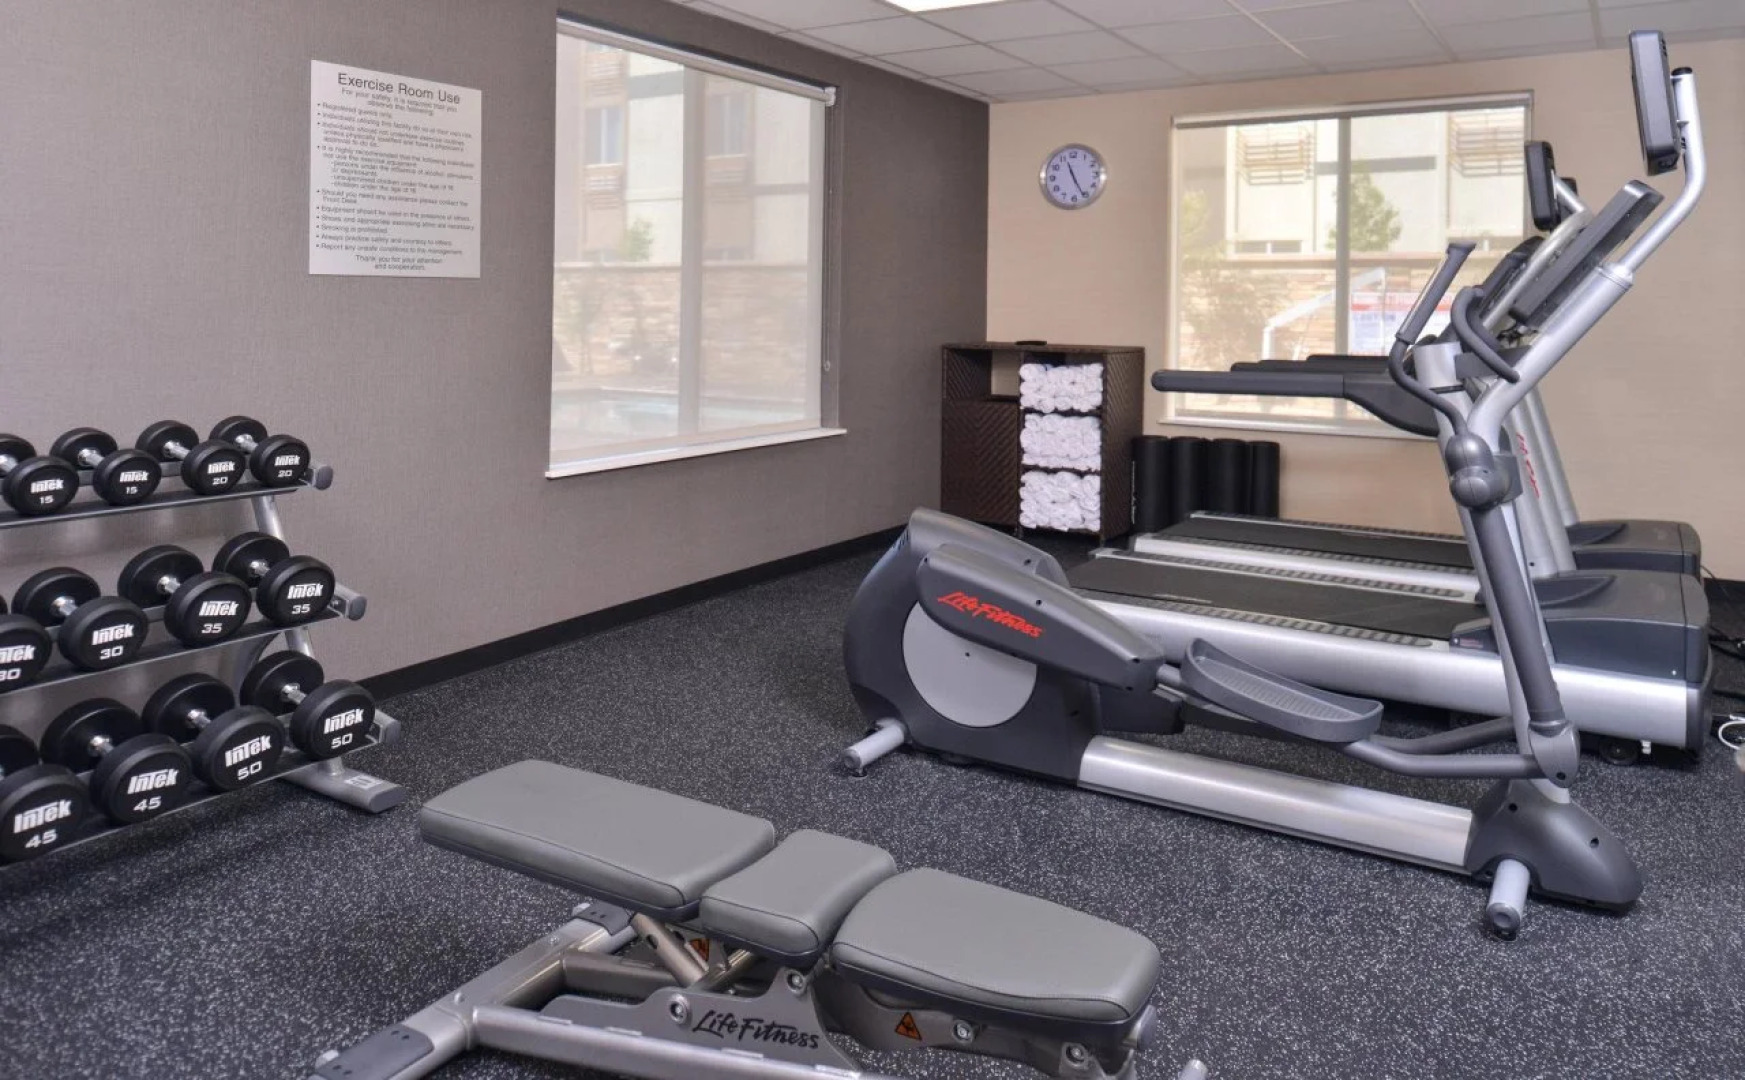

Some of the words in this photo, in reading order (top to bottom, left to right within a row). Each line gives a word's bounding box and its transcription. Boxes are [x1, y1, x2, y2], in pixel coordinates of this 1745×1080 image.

[338, 72, 393, 94] Exercise
[398, 82, 433, 100] Room
[438, 89, 460, 104] Use
[207, 461, 235, 474] InTek
[275, 455, 300, 466] InTek
[120, 470, 149, 483] InTek
[212, 477, 228, 485] 20
[31, 479, 64, 494] InTek
[126, 486, 138, 494] 15
[40, 495, 54, 504] 15
[287, 583, 323, 599] InTek
[199, 601, 239, 616] InTek
[292, 604, 311, 614] 35
[92, 623, 134, 645] InTek
[201, 623, 222, 633] 35
[0, 645, 36, 664] nTek
[100, 646, 124, 660] 30
[324, 709, 364, 734] InTek
[331, 734, 353, 749] 50
[224, 735, 272, 767] InTek
[237, 761, 262, 780] 50
[127, 768, 179, 794] InTek
[133, 796, 161, 812] 45
[13, 799, 72, 833] InTek
[25, 829, 58, 848] 45
[692, 1009, 739, 1038] Life
[738, 1018, 819, 1049] Fitness
